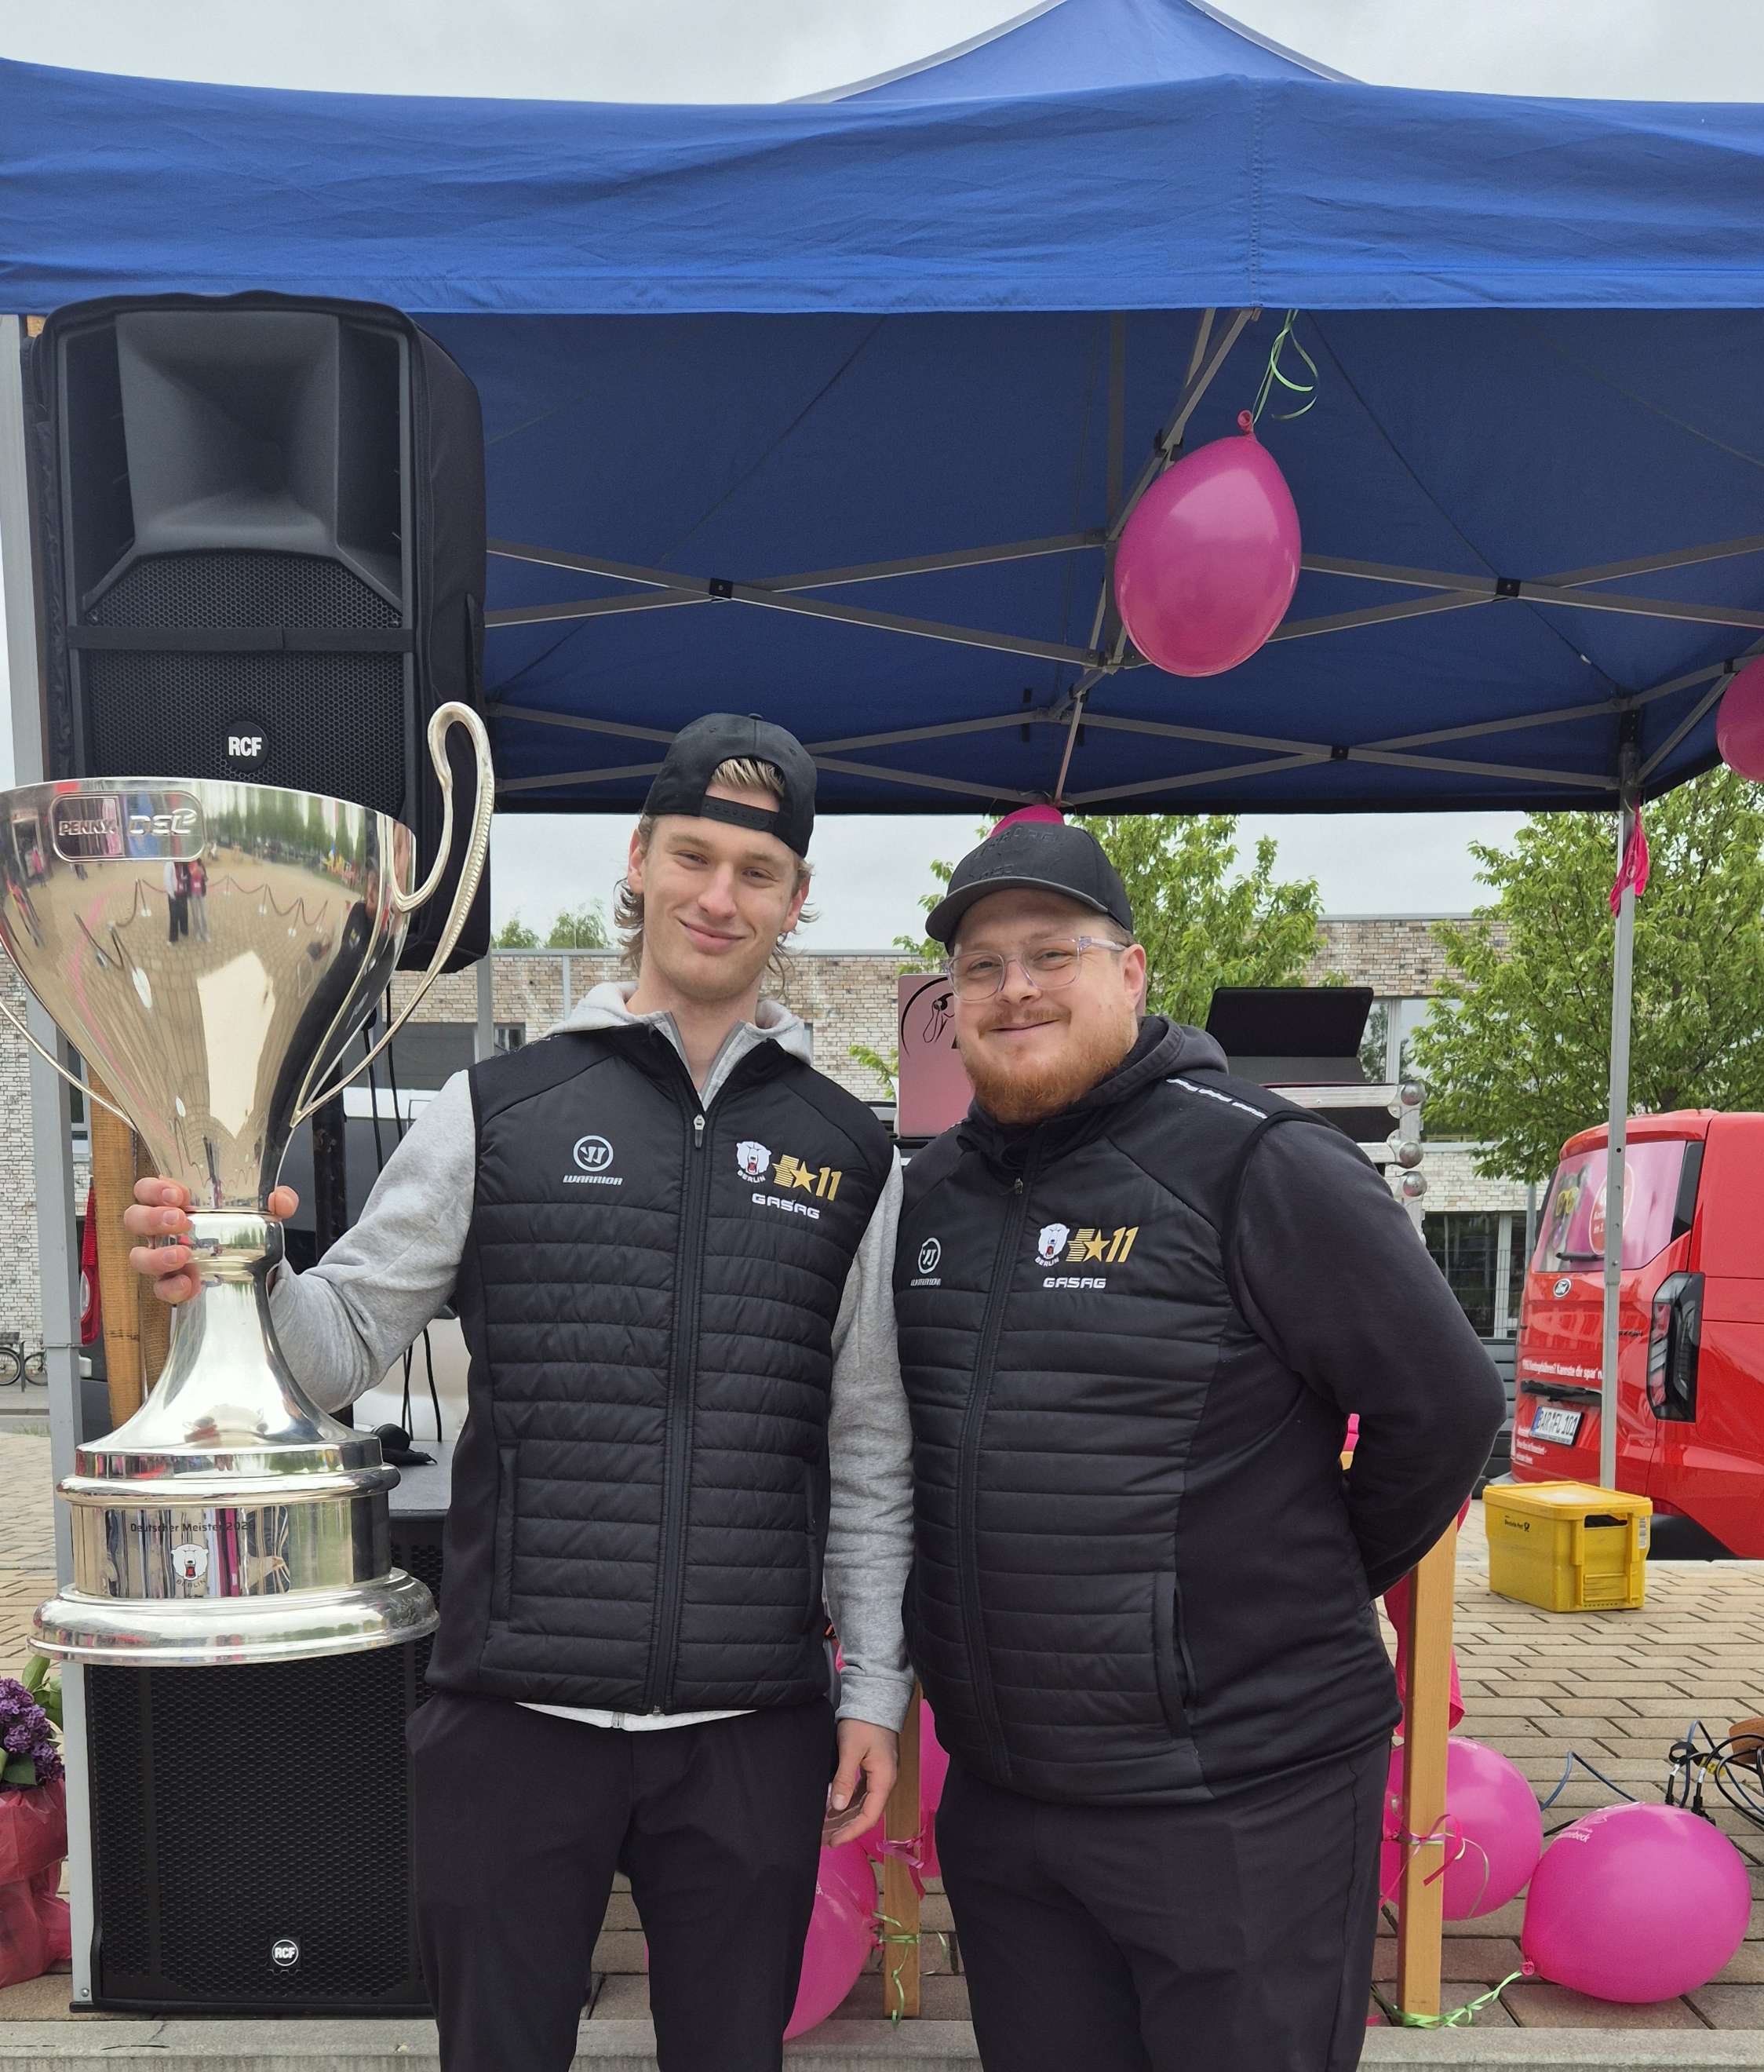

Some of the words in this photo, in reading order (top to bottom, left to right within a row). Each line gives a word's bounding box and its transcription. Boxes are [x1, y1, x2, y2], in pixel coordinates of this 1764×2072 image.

[228, 736, 262, 757] RCF
[563, 1175, 623, 1186] WARRIOR
[737, 1169, 766, 1184] BERLIN
[816, 1166, 842, 1201] 11
[752, 1193, 820, 1220] GASAG
[1106, 1226, 1139, 1263] 11
[1035, 1257, 1059, 1267] BERLIN
[1043, 1277, 1106, 1288] GASAG
[1562, 1415, 1578, 1435] 101
[131, 1523, 179, 1532] Deutscher
[226, 1521, 255, 1530] 202
[275, 1947, 295, 1959] RCF
